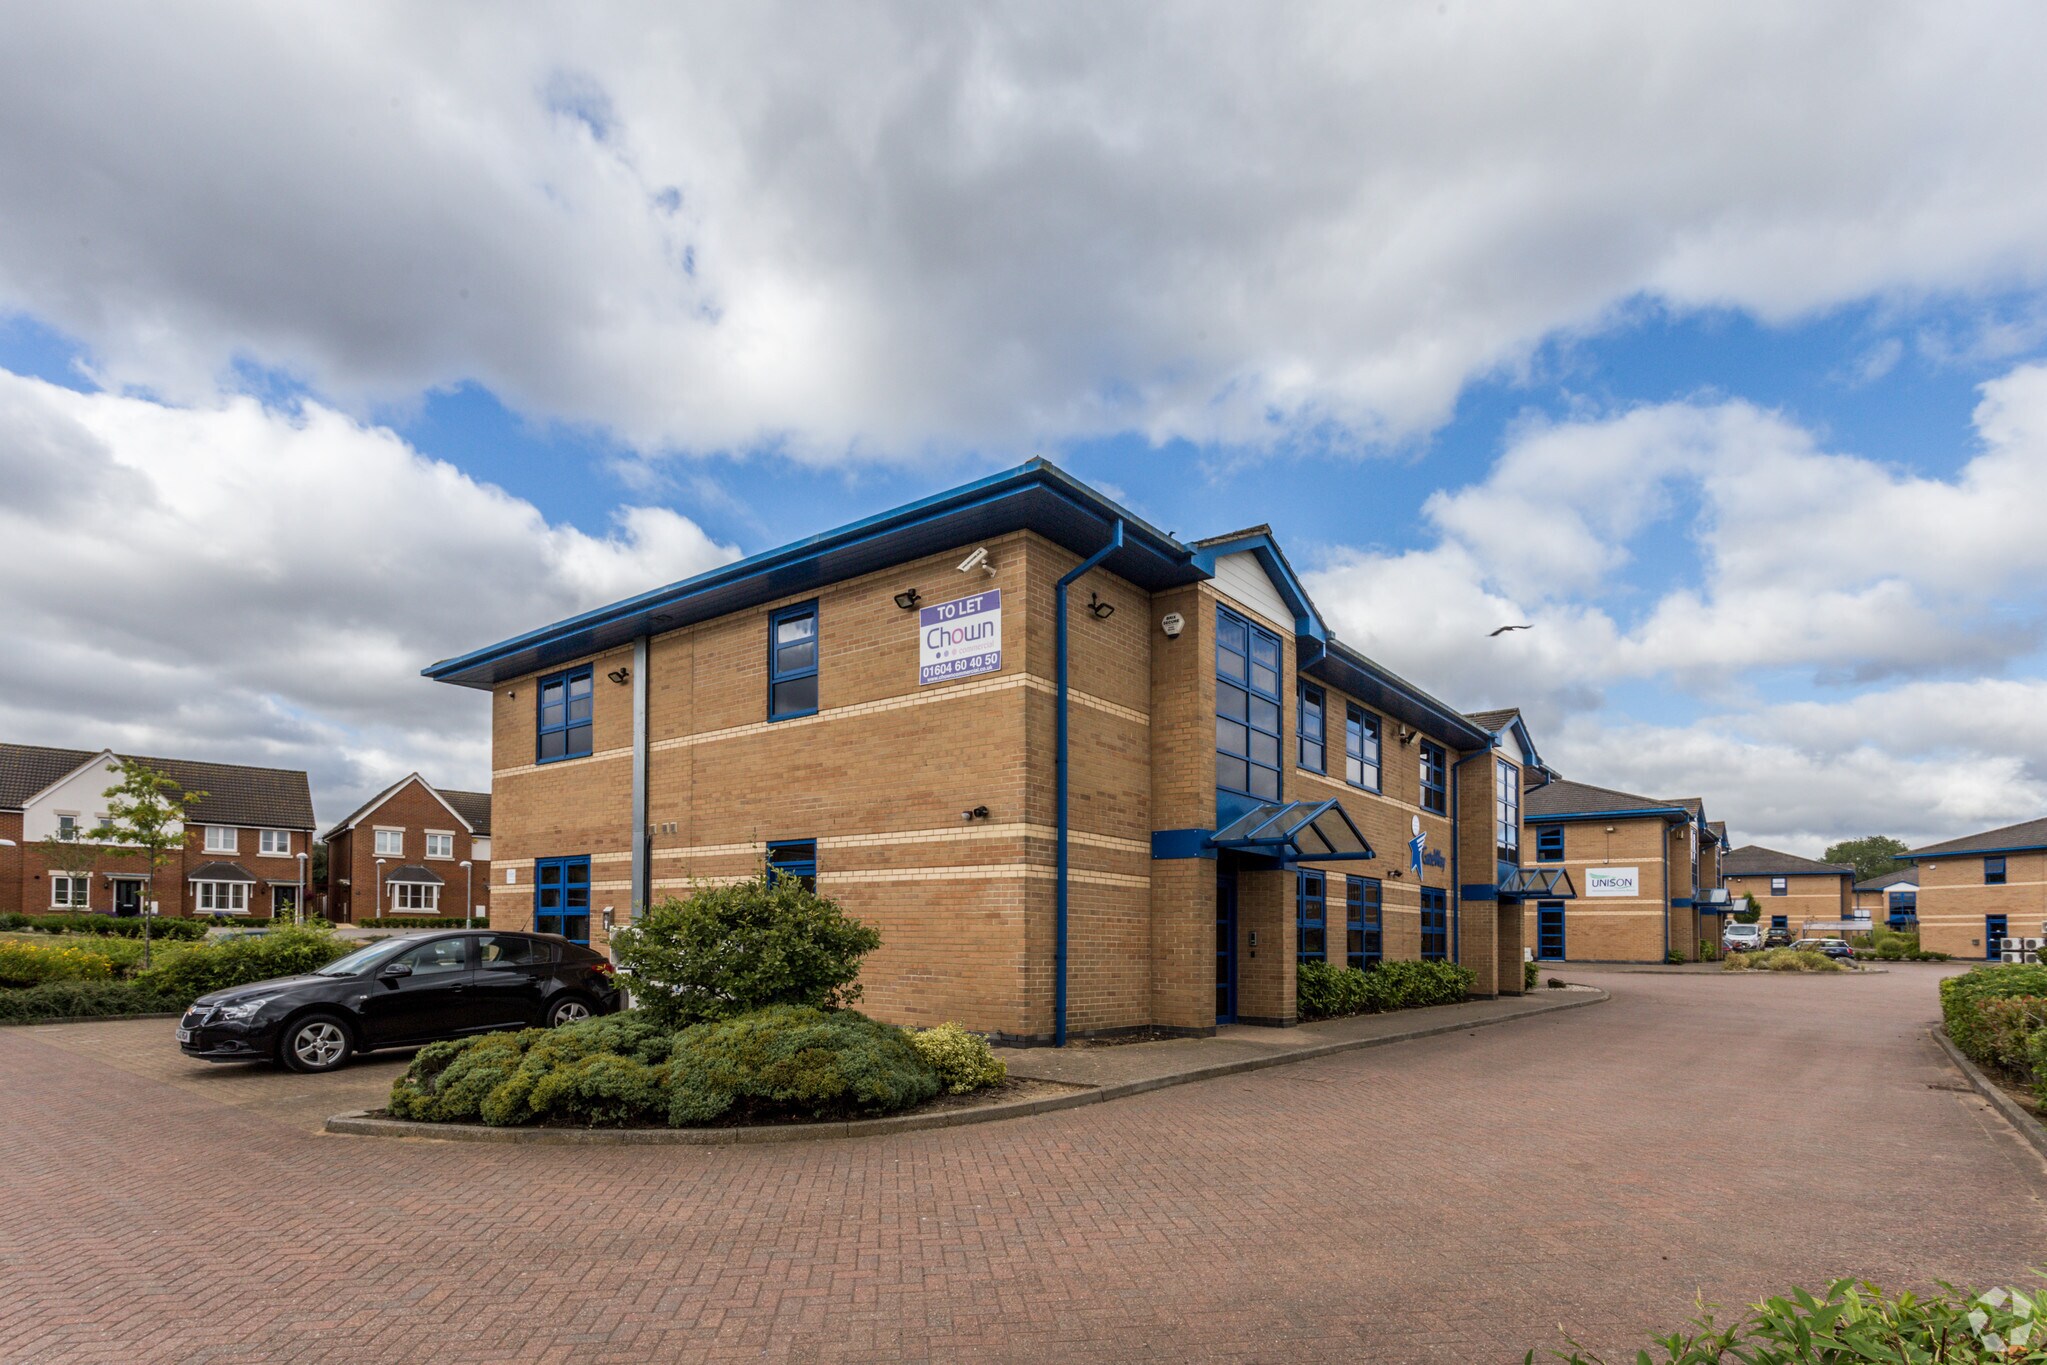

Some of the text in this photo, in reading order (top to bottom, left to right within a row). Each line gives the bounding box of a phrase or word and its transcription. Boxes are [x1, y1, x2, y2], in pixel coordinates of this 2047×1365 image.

[937, 597, 984, 620] TO LET
[927, 621, 994, 649] Chown
[959, 642, 994, 654] commercial
[923, 653, 998, 678] 01604 60 40 50
[1592, 878, 1632, 887] UNISON
